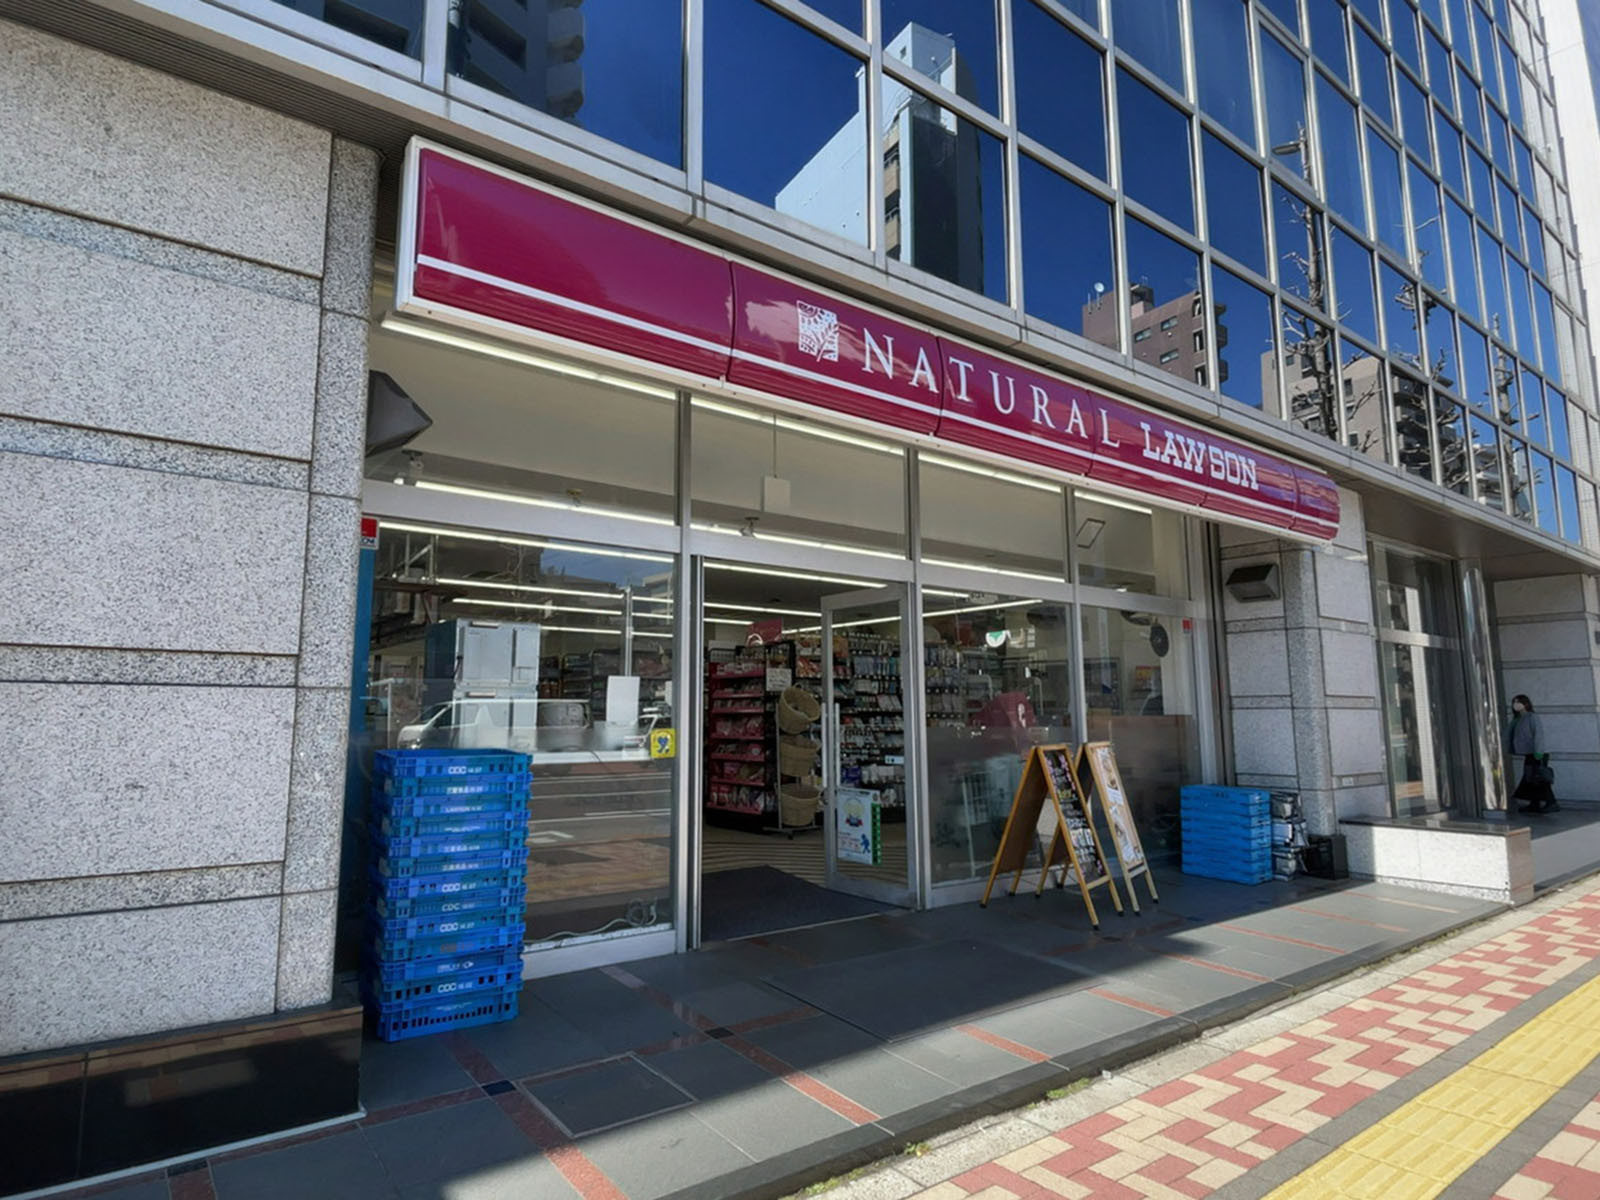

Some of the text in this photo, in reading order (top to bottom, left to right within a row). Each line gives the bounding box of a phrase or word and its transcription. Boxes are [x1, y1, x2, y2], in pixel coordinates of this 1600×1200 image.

[861, 327, 1259, 490] NATURAL LAWSON
[442, 903, 460, 912] CDC
